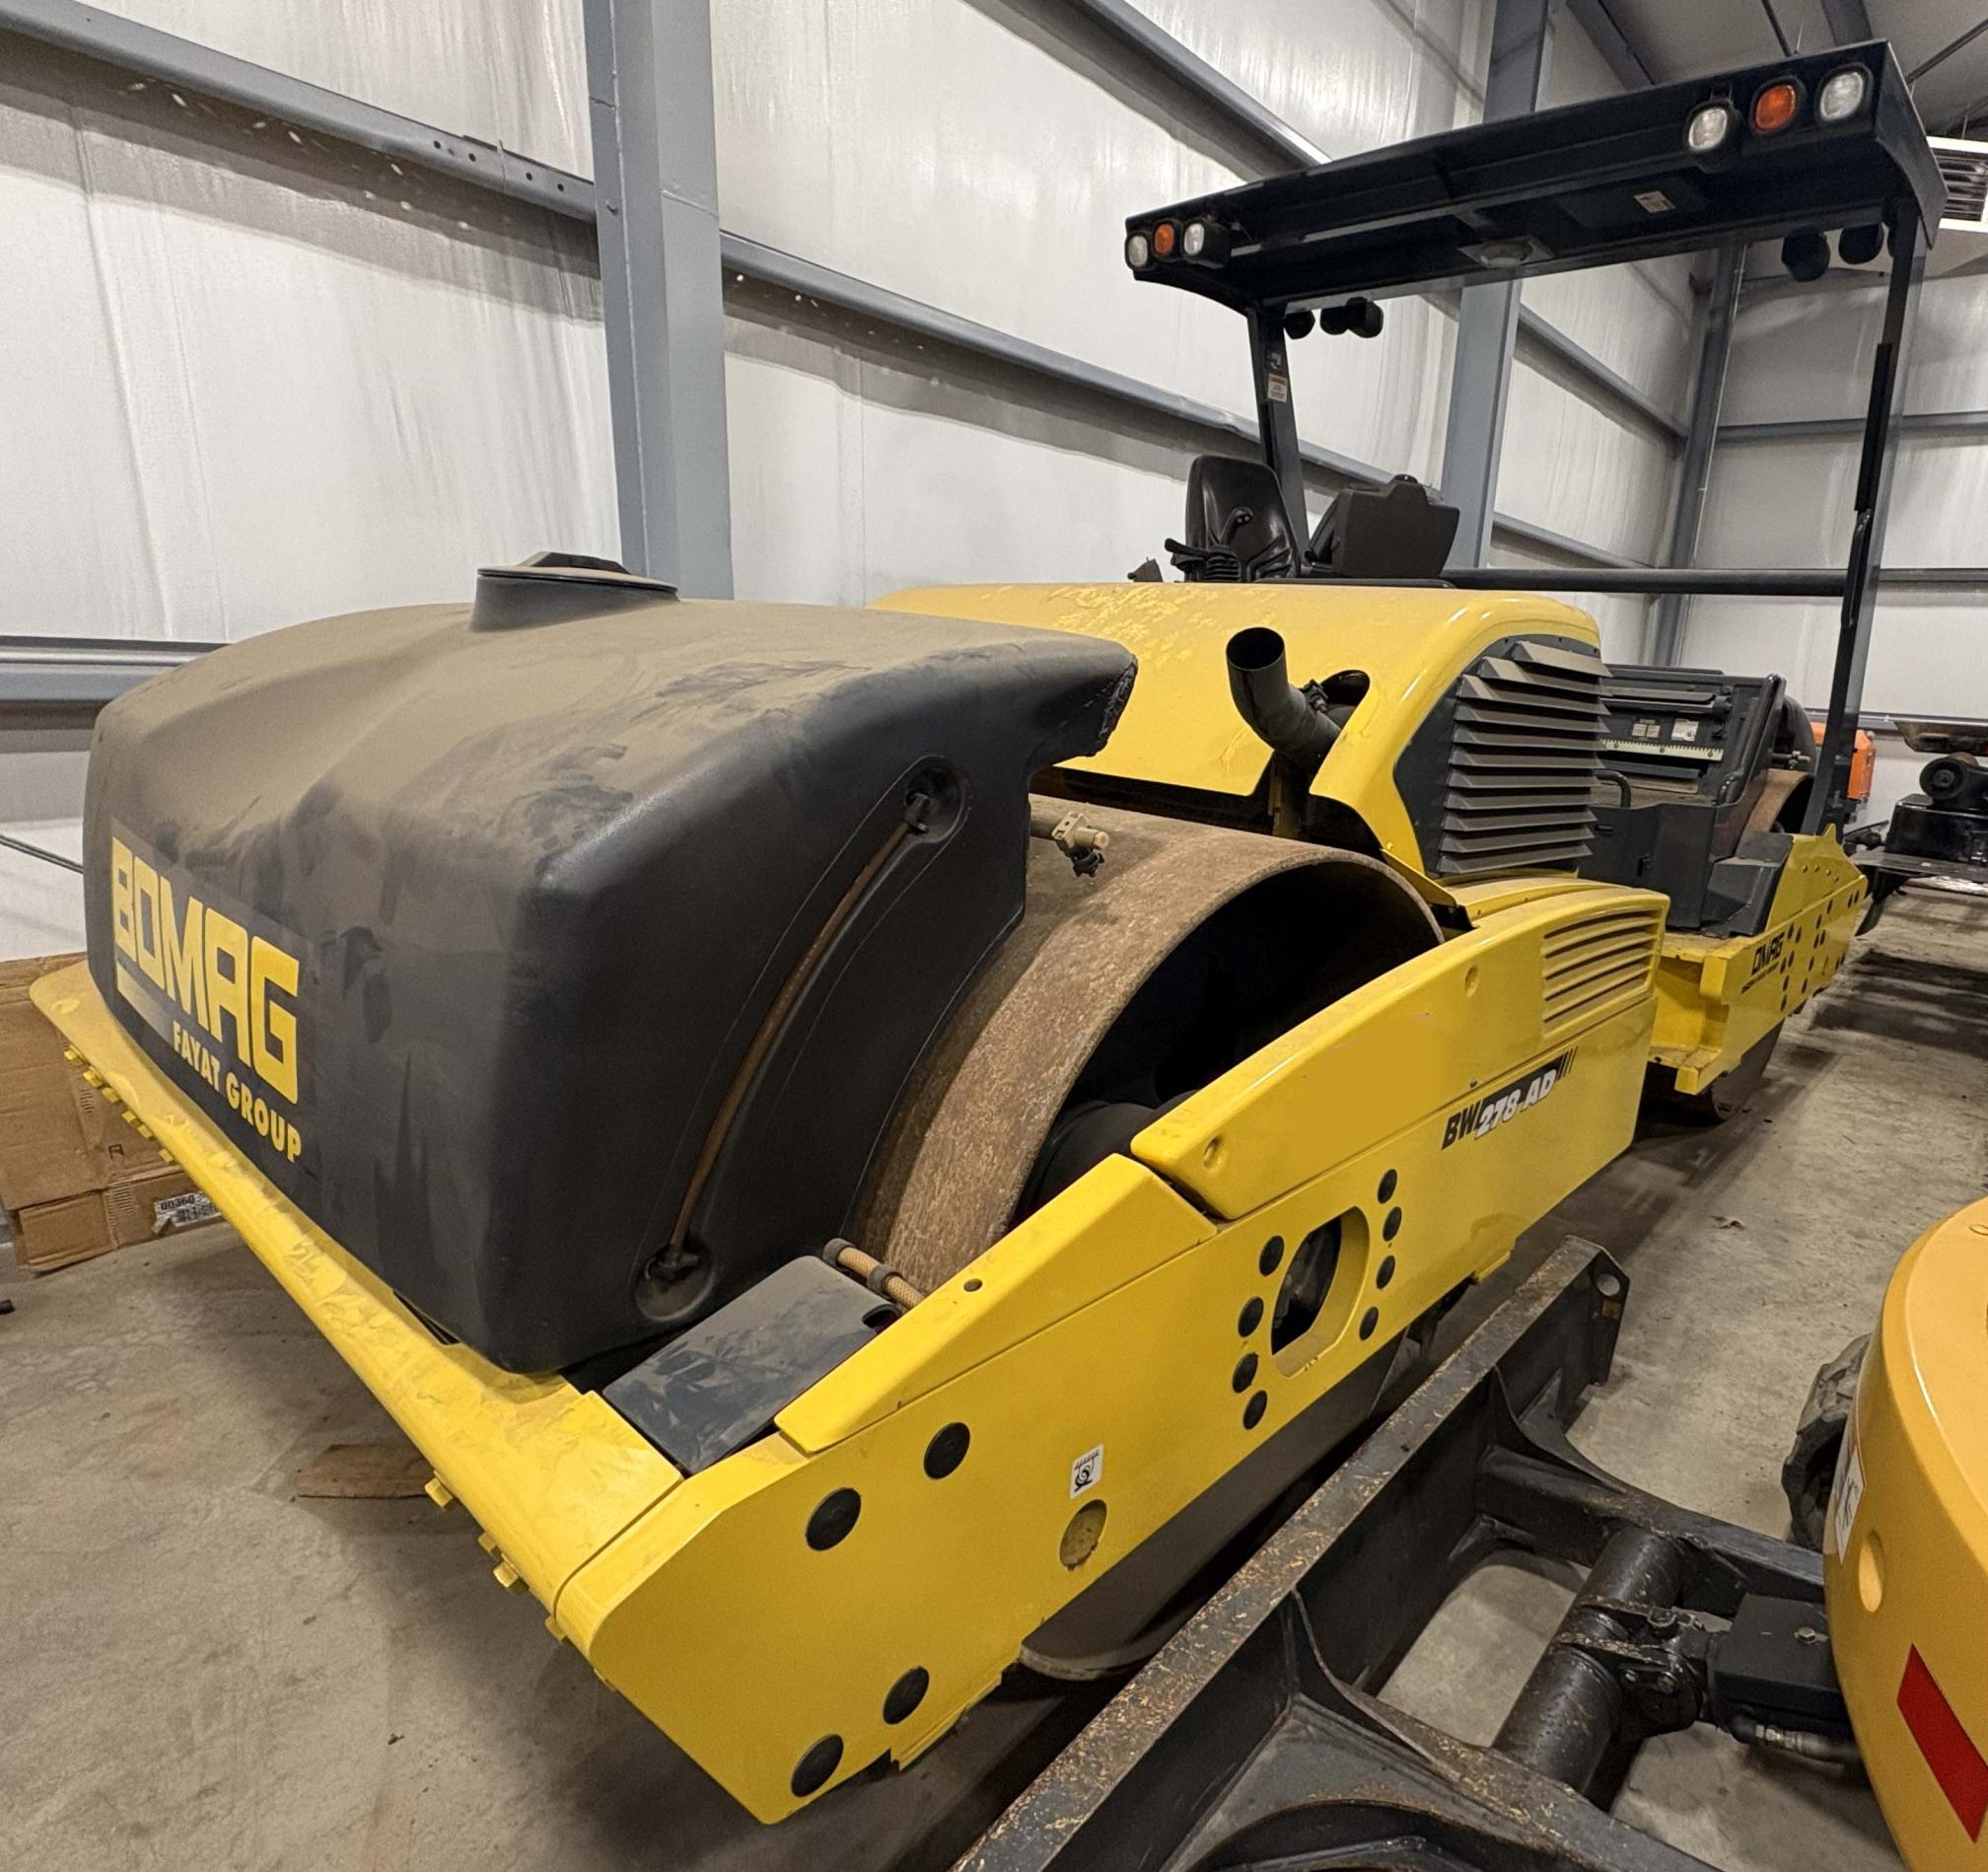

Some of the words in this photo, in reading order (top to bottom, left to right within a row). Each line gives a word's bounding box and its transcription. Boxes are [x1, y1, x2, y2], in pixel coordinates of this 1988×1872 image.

[111, 835, 300, 1105] BOMAG
[172, 1019, 221, 1092] FAYAT
[225, 1071, 302, 1164] GROUP
